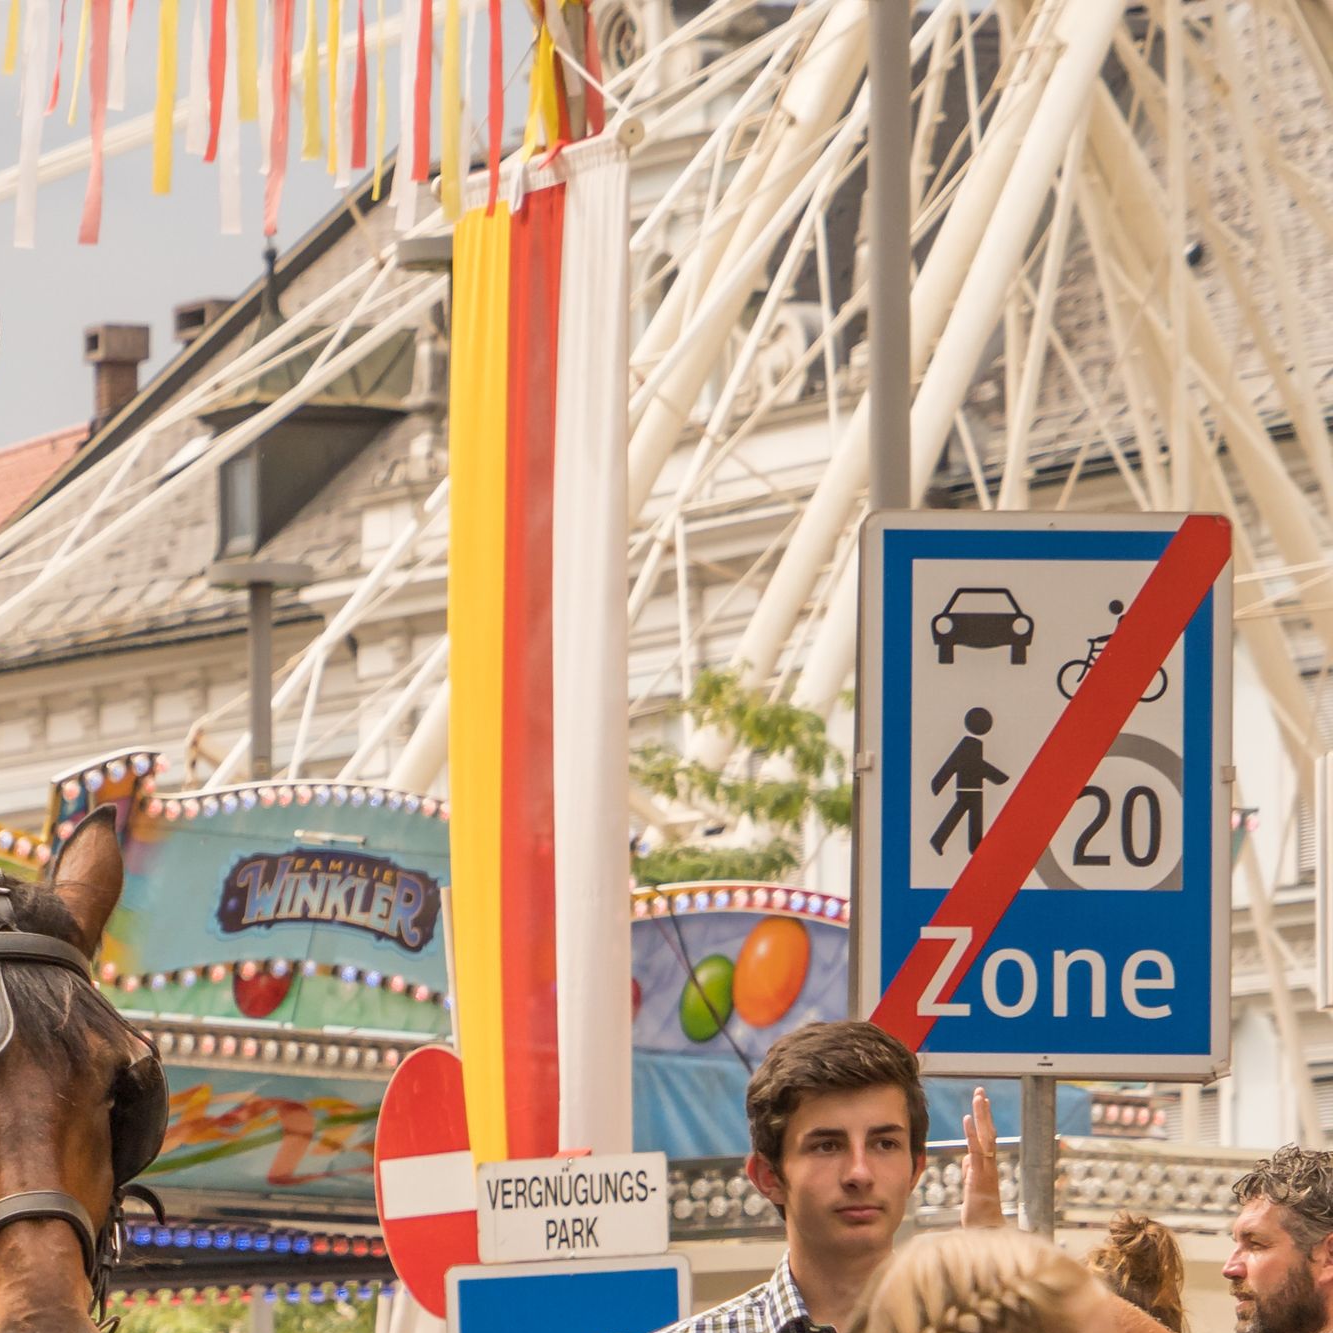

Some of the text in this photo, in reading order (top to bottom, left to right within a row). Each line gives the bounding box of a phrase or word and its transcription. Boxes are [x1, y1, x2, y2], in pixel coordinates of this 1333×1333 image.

[1073, 785, 1162, 867] 20
[236, 856, 424, 947] WINKLER
[294, 858, 397, 885] FAMILIE
[916, 926, 1175, 1019] Zone
[486, 1167, 657, 1210] VERGNÜGUNGS-
[545, 1217, 599, 1250] PARK
